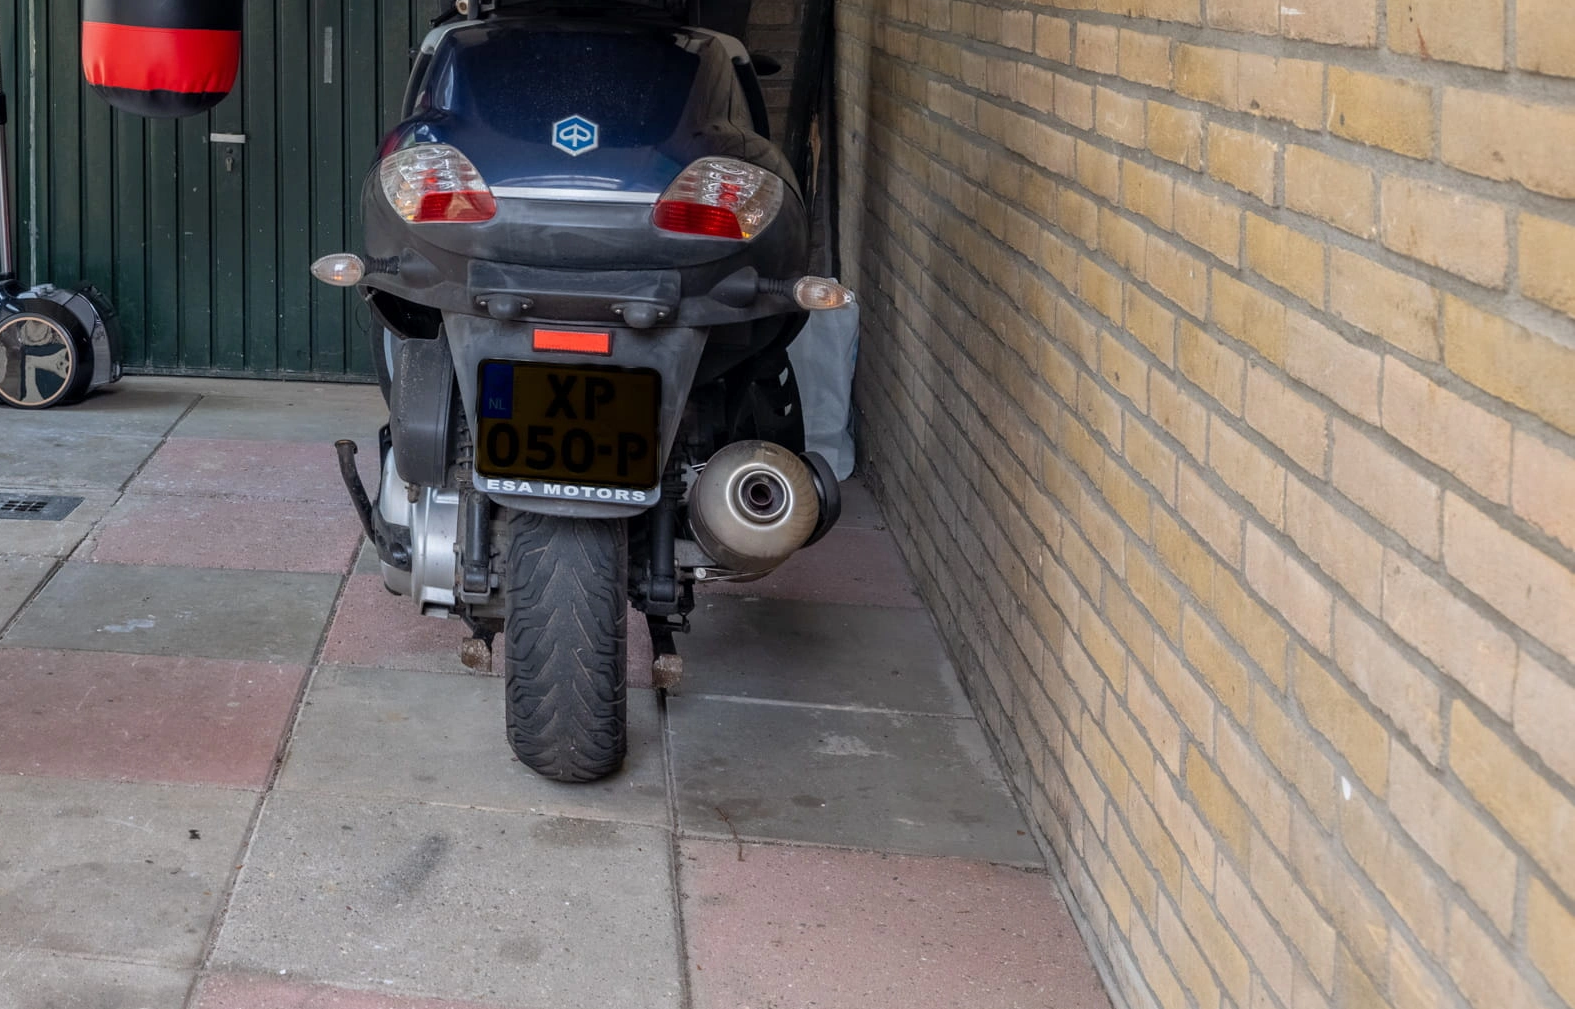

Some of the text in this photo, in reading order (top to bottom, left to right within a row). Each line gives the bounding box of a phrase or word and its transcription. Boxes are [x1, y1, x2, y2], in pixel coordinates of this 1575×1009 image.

[488, 398, 506, 411] NL
[545, 374, 616, 421] XP
[486, 422, 648, 477] 050-P
[486, 479, 646, 502] ESA MOTORS
